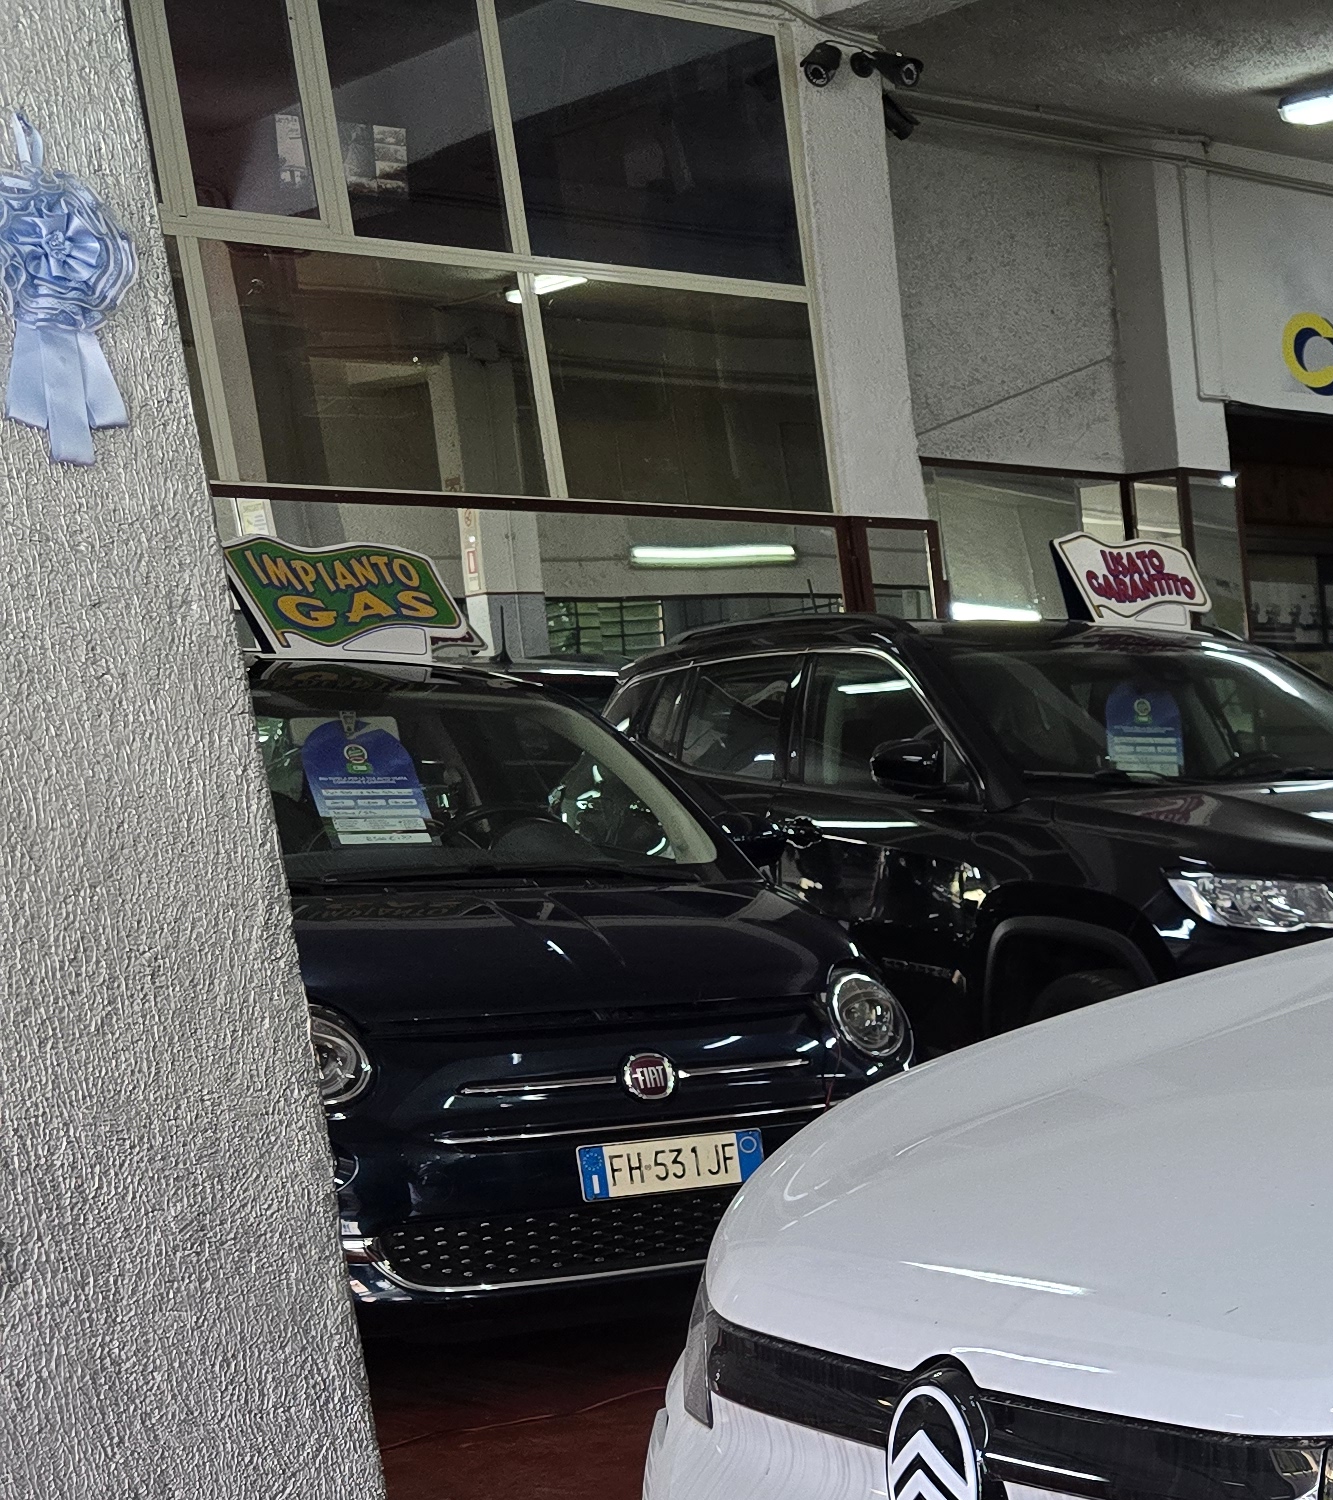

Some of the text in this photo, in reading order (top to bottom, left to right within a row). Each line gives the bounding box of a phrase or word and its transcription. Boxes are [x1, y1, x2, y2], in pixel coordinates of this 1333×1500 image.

[243, 550, 421, 593] IMPIANTO
[1100, 549, 1165, 577] USATO
[1086, 570, 1196, 603] GARANTITO
[275, 590, 438, 629] GAS
[635, 1065, 665, 1089] FIAT
